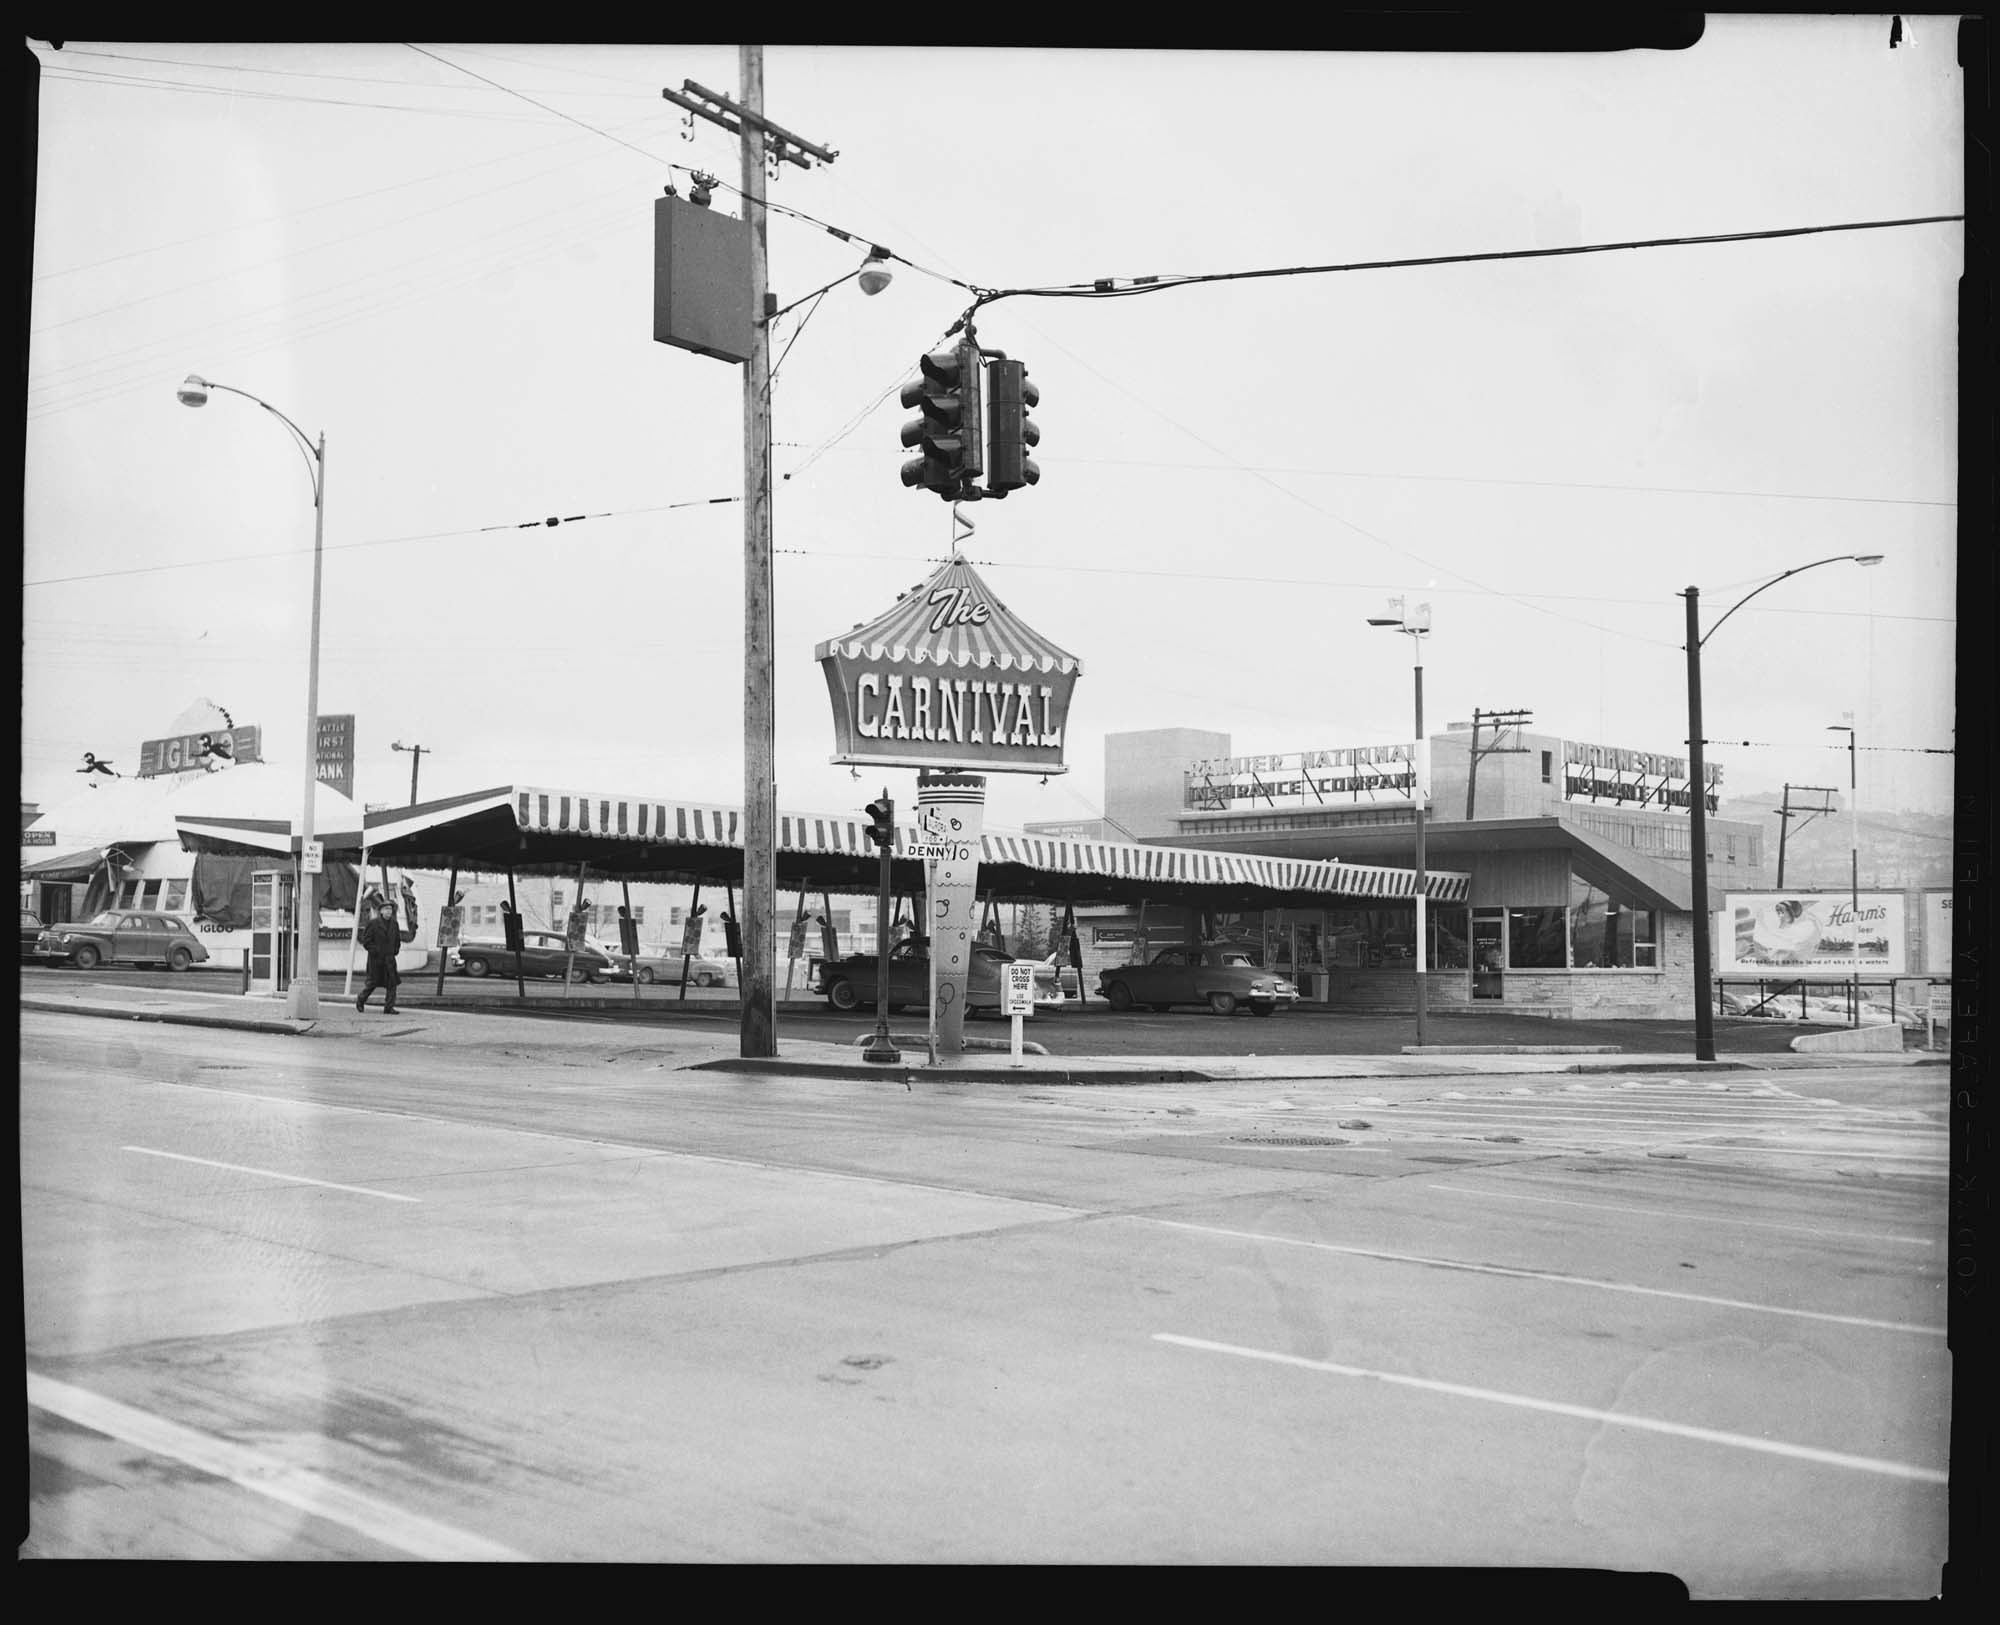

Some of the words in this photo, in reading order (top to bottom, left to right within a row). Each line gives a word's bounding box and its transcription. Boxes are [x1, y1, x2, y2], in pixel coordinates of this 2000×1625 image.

[928, 586, 991, 634] The
[858, 672, 1062, 748] CARNIVAL
[317, 723, 345, 733] ATTLE
[319, 735, 345, 748] IRST
[316, 751, 345, 761] ATIONAL
[315, 762, 345, 780] ANK
[1703, 761, 1724, 785] IFE
[1189, 780, 1302, 801] INSURANCE
[1318, 772, 1417, 793] COMPANY
[1657, 788, 1720, 812] COMNY
[908, 845, 952, 861] DENNY
[1825, 902, 1887, 927] Hamm's
[200, 924, 234, 934] IGLOO
[1011, 968, 1019, 976] DO
[1020, 967, 1031, 976] NOT
[1012, 975, 1030, 983] CROSS
[1013, 983, 1029, 991] HERE
